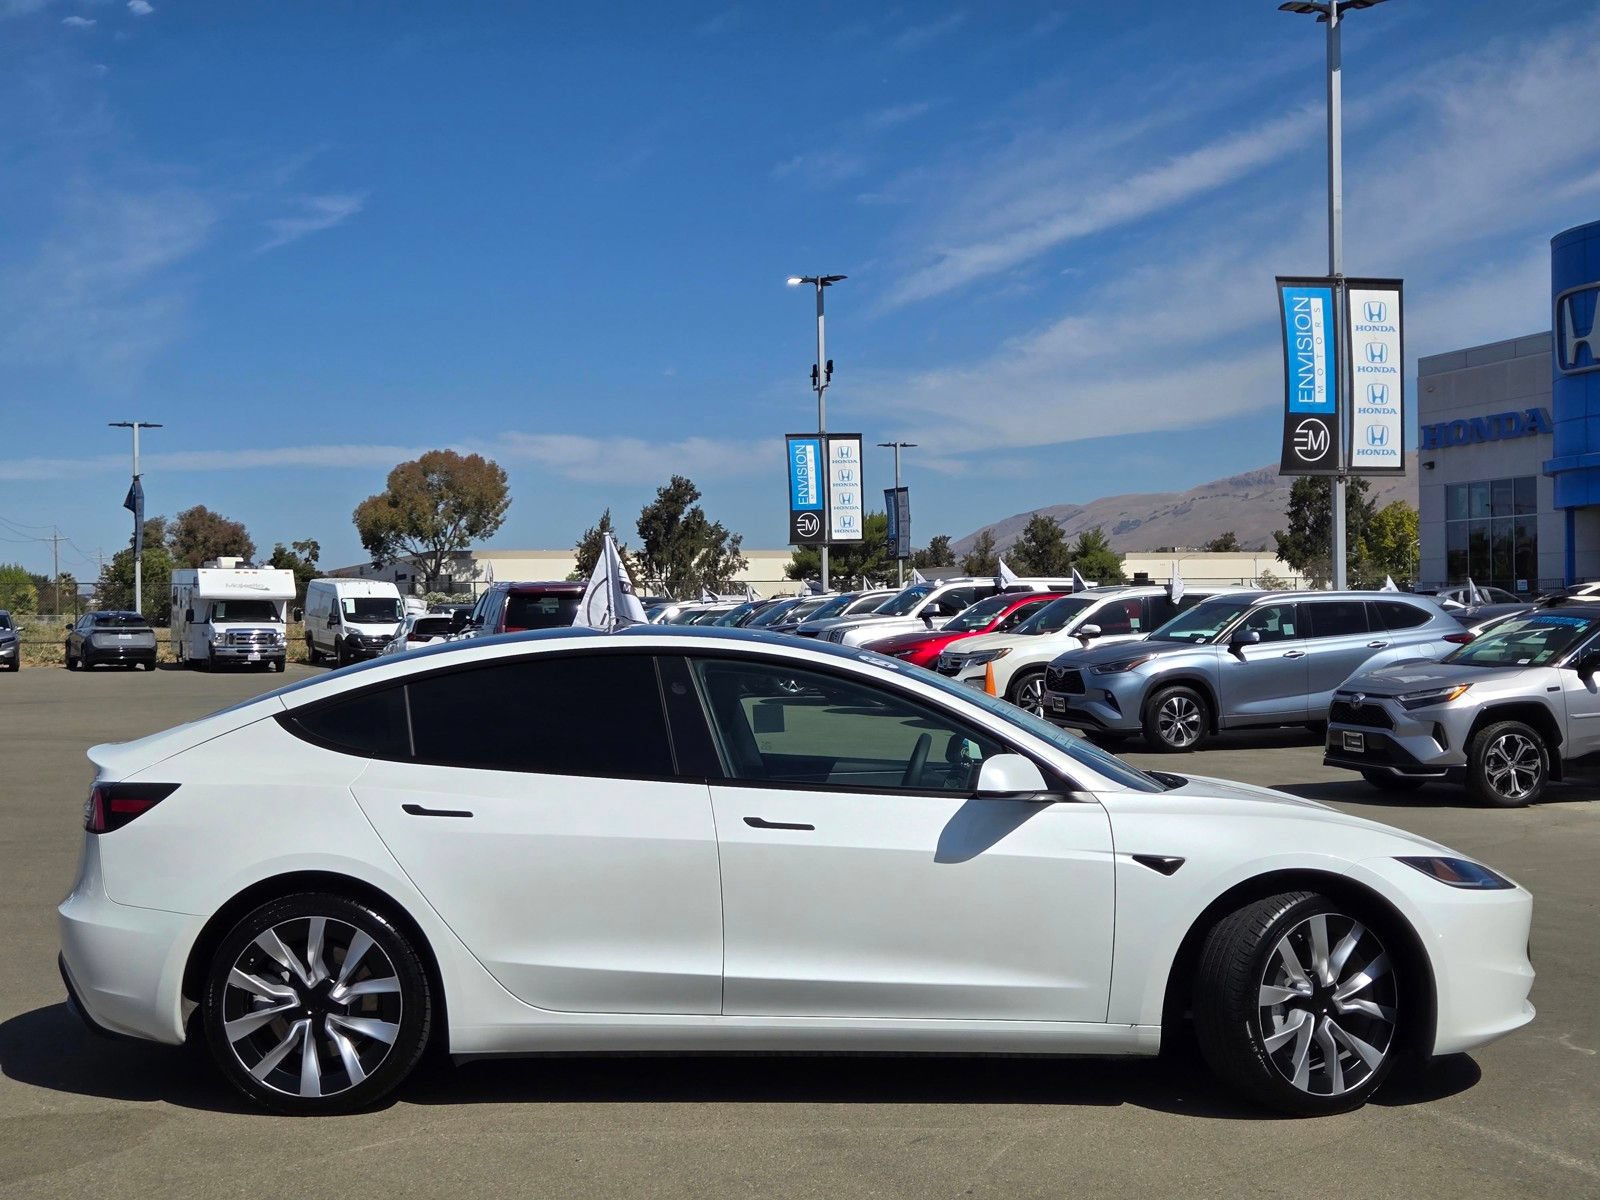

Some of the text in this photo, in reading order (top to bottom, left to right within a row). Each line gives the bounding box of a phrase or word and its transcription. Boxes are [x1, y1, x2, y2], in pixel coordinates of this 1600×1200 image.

[1293, 297, 1315, 403] ENVISION
[1355, 325, 1397, 333] HONDA
[1314, 307, 1324, 394] MOTORS
[1357, 366, 1398, 374] HONDA
[1357, 407, 1398, 415] HONDA
[1421, 408, 1553, 450] HONDA
[795, 445, 808, 504] ENVISION
